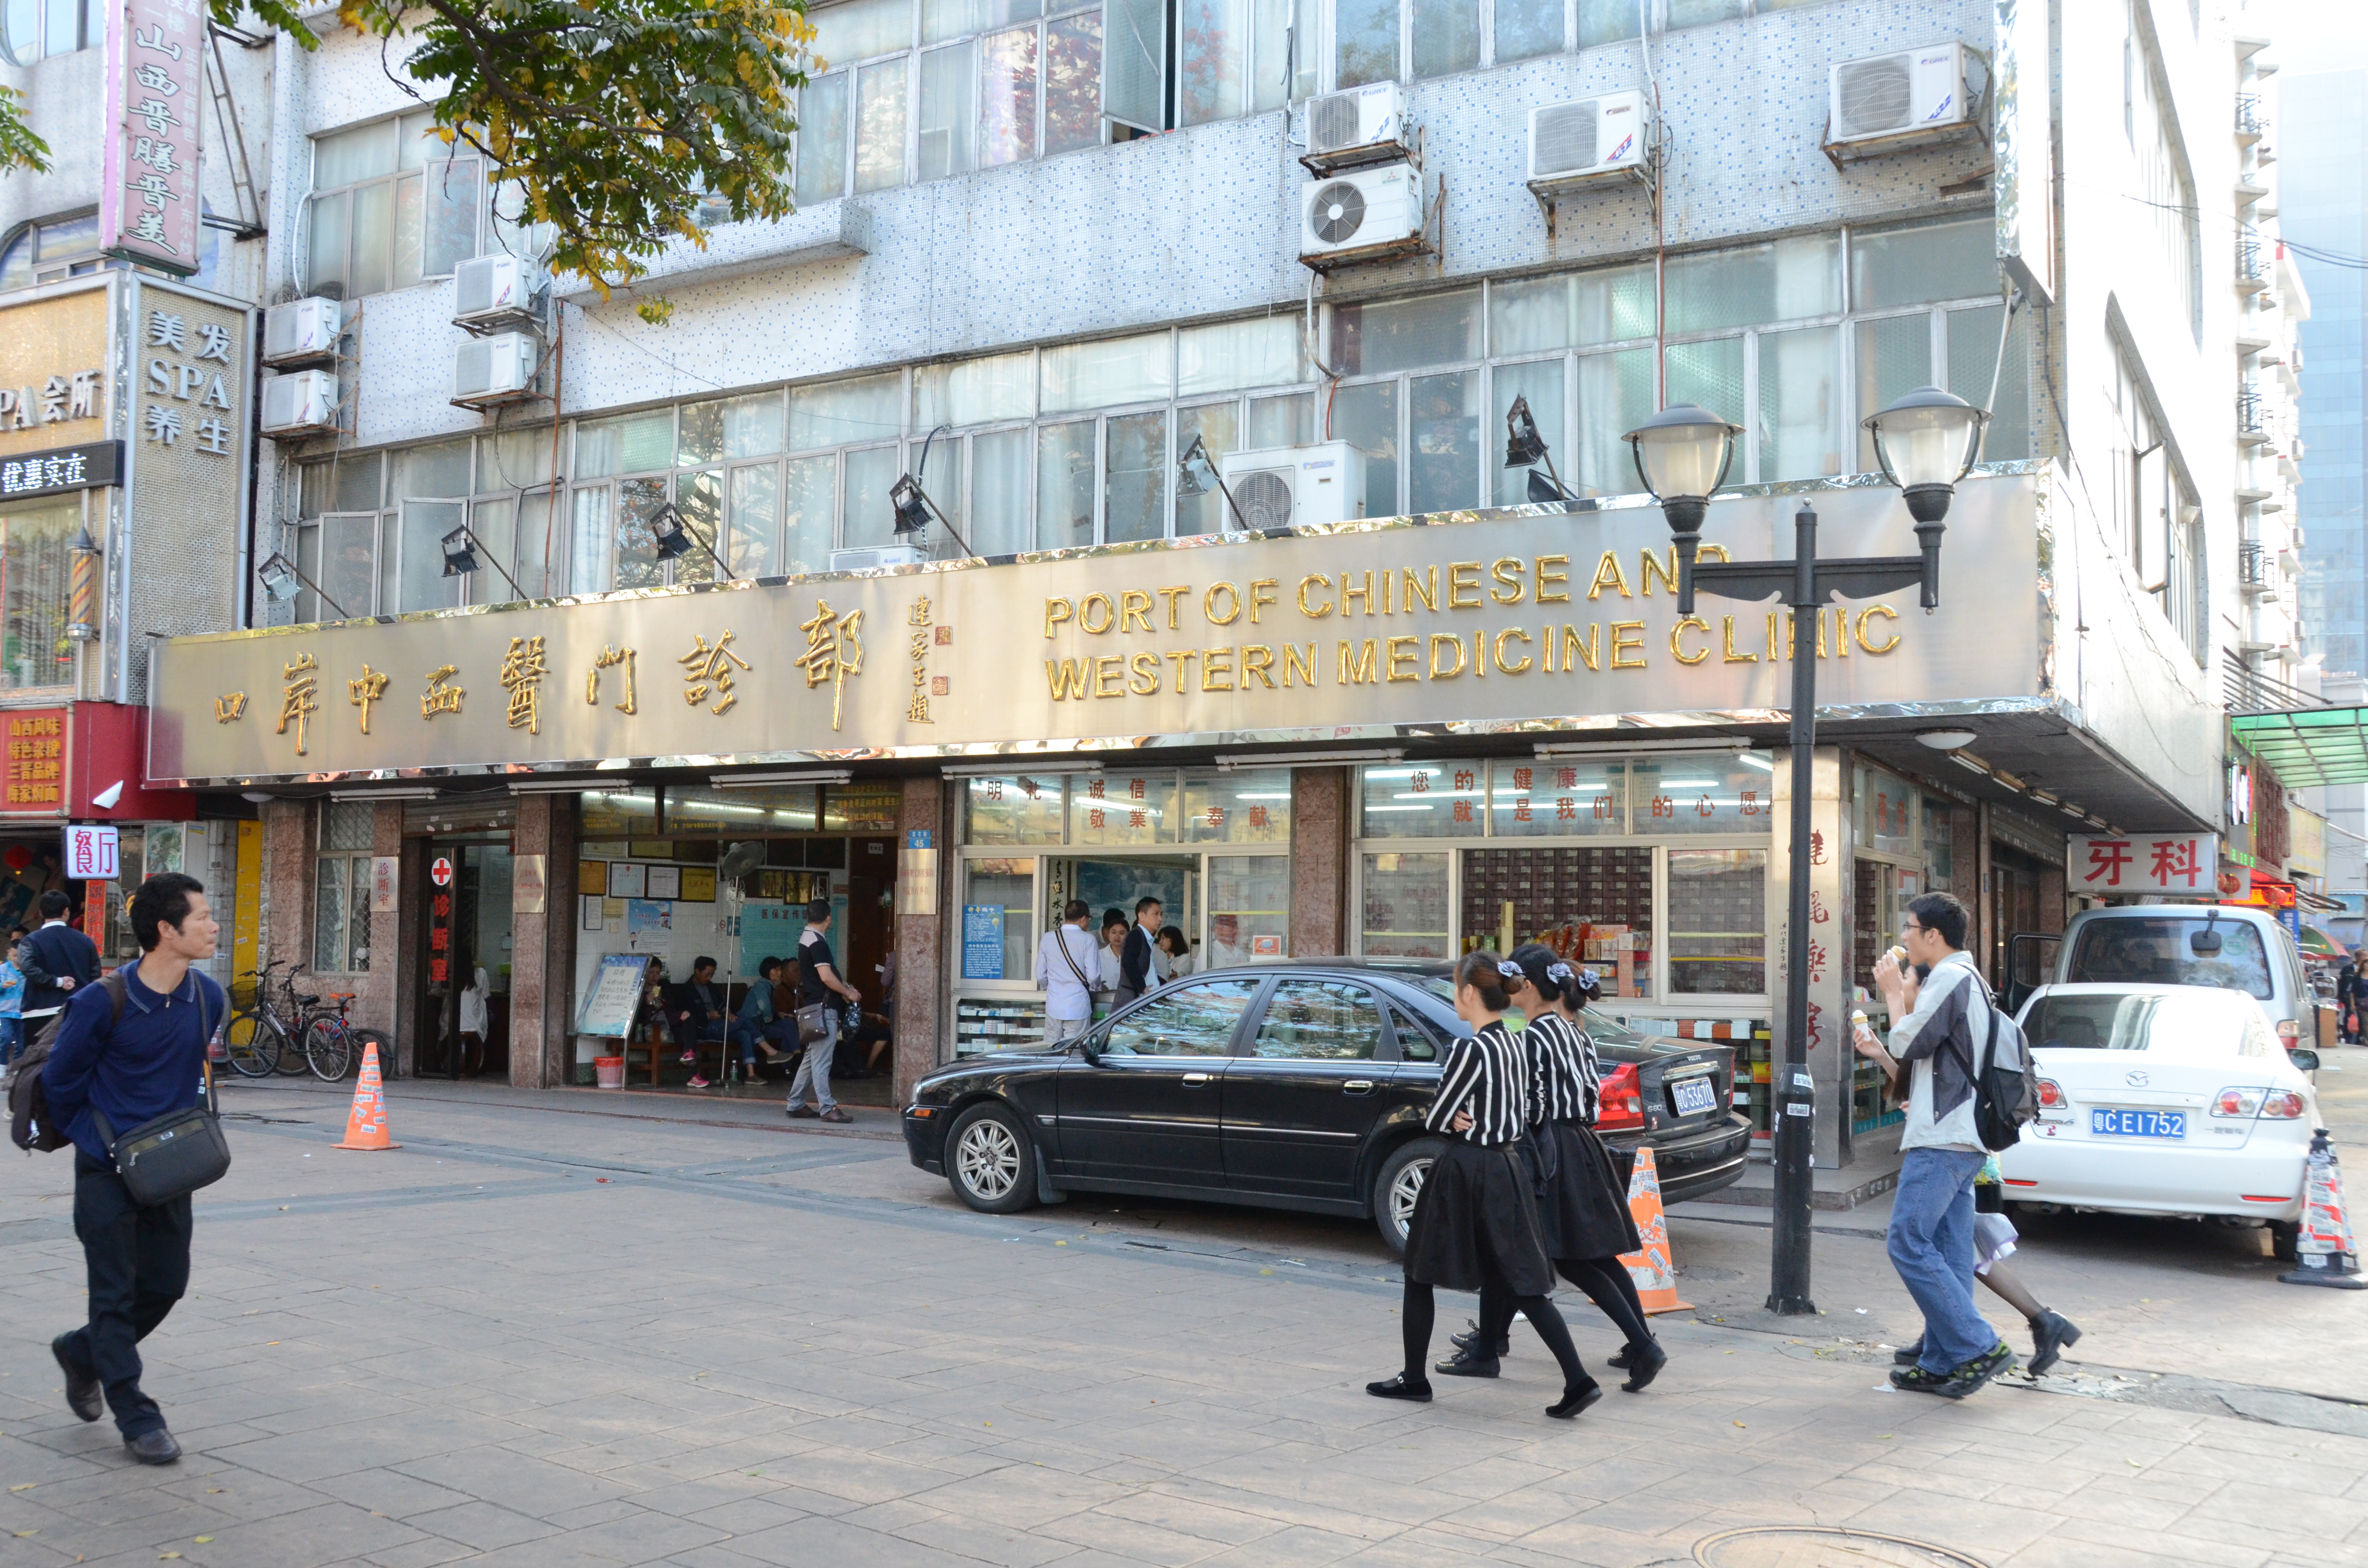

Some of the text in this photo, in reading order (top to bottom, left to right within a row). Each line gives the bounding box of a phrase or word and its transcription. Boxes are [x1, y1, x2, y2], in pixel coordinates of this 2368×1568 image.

[1369, 87, 1388, 95] GREE
[148, 310, 232, 364] 美发
[147, 358, 232, 410] SPA
[146, 405, 230, 455] 养生
[1045, 585, 1191, 639] PORT
[1203, 578, 1279, 626] OF
[1297, 553, 1571, 619] CHINESE
[1045, 640, 1318, 701] WESTERN
[1337, 620, 1647, 685] MEDICINE
[1411, 767, 1577, 792] 您的健康
[75, 830, 115, 874] 餐厅
[914, 839, 924, 848] 45
[2084, 840, 2202, 887] 牙科
